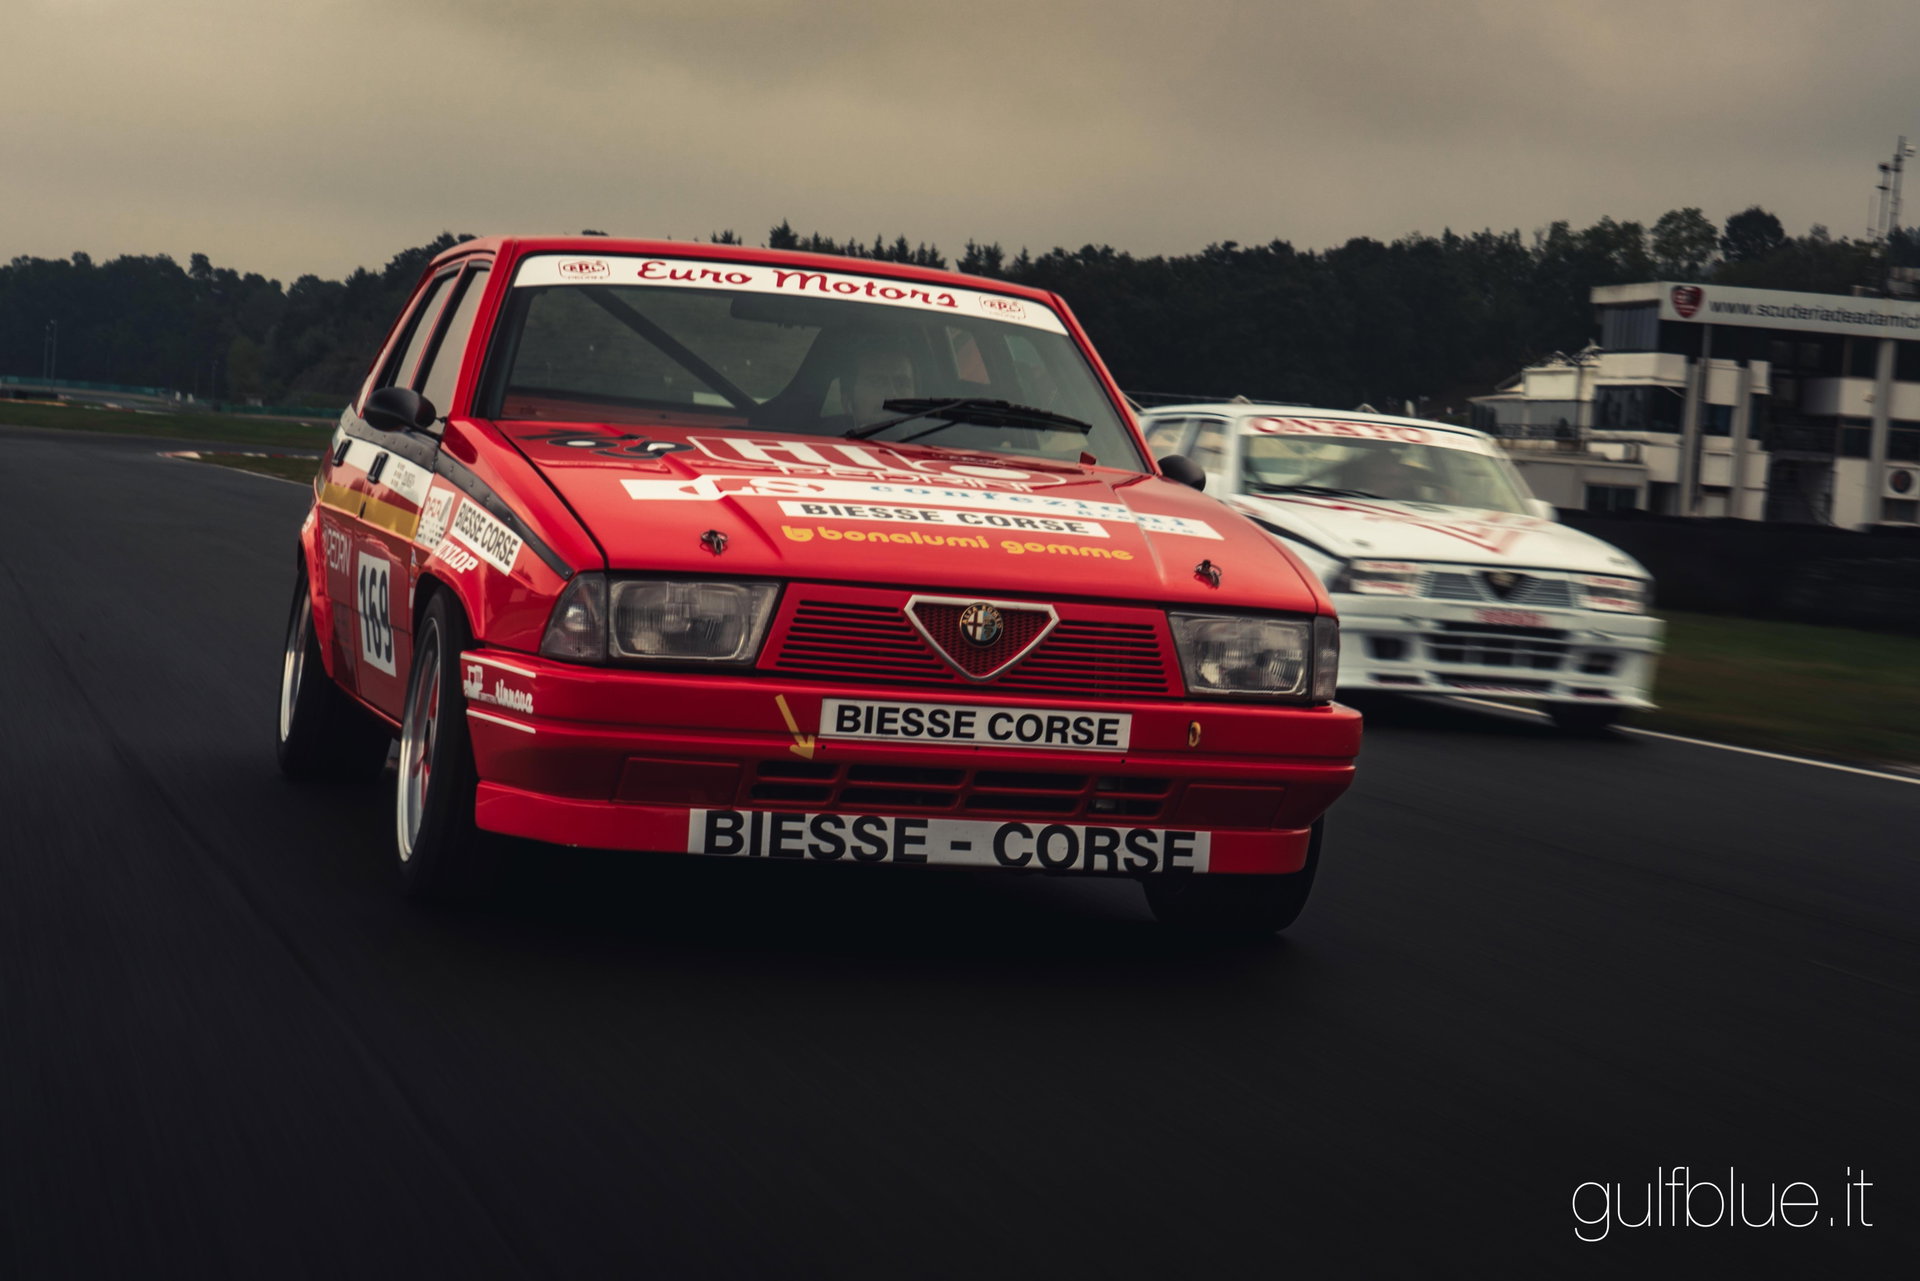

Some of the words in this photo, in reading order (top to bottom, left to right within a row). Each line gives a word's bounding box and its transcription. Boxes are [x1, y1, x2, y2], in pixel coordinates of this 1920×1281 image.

[636, 260, 753, 286] Euro
[772, 269, 960, 308] Motors
[454, 502, 487, 543] BIESSE
[481, 522, 519, 567] CORSE
[800, 503, 945, 523] BIESSE
[956, 512, 1090, 534] CORSE
[817, 526, 990, 549] bonalumi
[1000, 539, 1134, 560] gomme
[359, 564, 393, 664] 169
[835, 704, 976, 739] BIESSE
[987, 711, 1120, 746] CORSE
[704, 809, 929, 863] BIESSE
[993, 822, 1196, 874] CORSE
